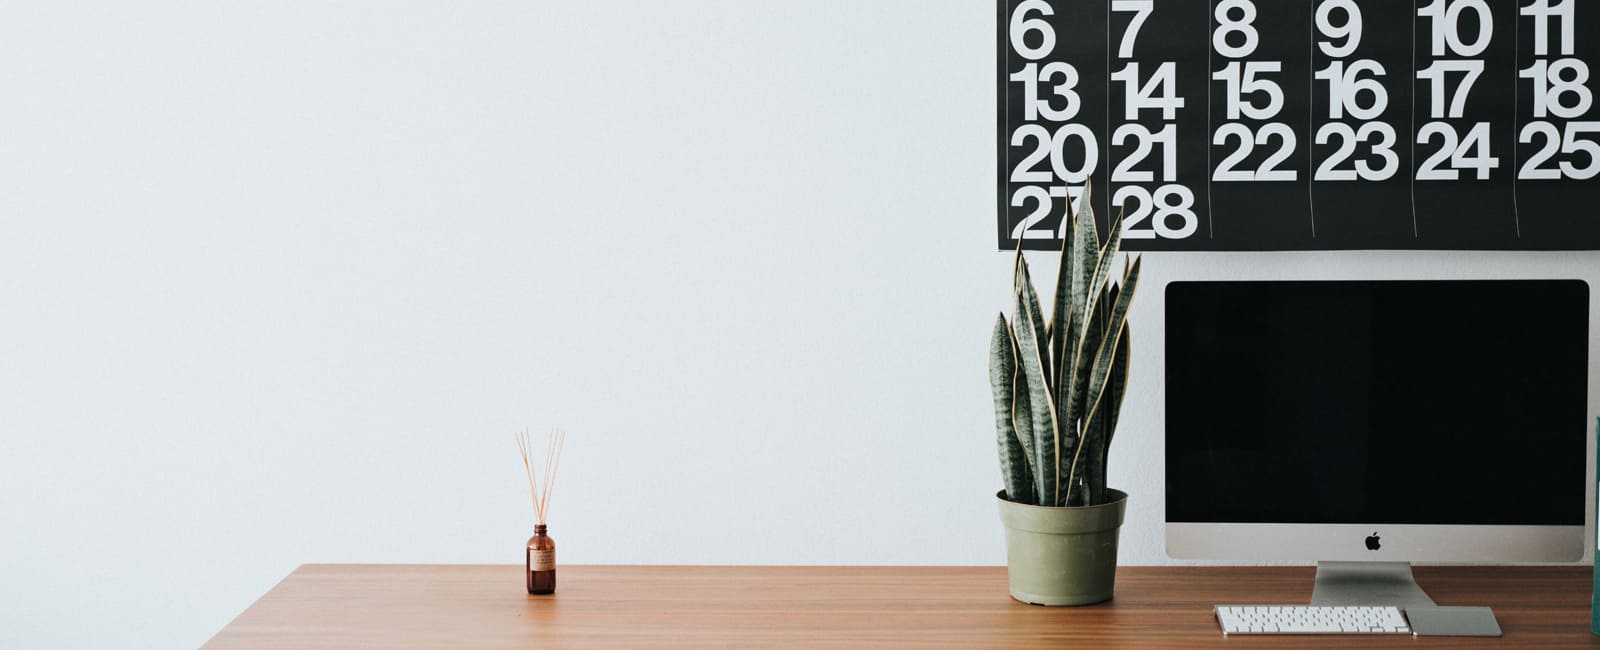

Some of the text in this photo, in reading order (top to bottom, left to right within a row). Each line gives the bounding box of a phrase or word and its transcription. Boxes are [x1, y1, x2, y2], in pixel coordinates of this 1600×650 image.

[1010, 0, 1574, 60] 6 7 8 9 10 11
[1010, 58, 1592, 121] 13 14 15 16 17 18
[1011, 121, 1600, 183] 20 21 22 23 24 25
[1112, 184, 1198, 239] 28
